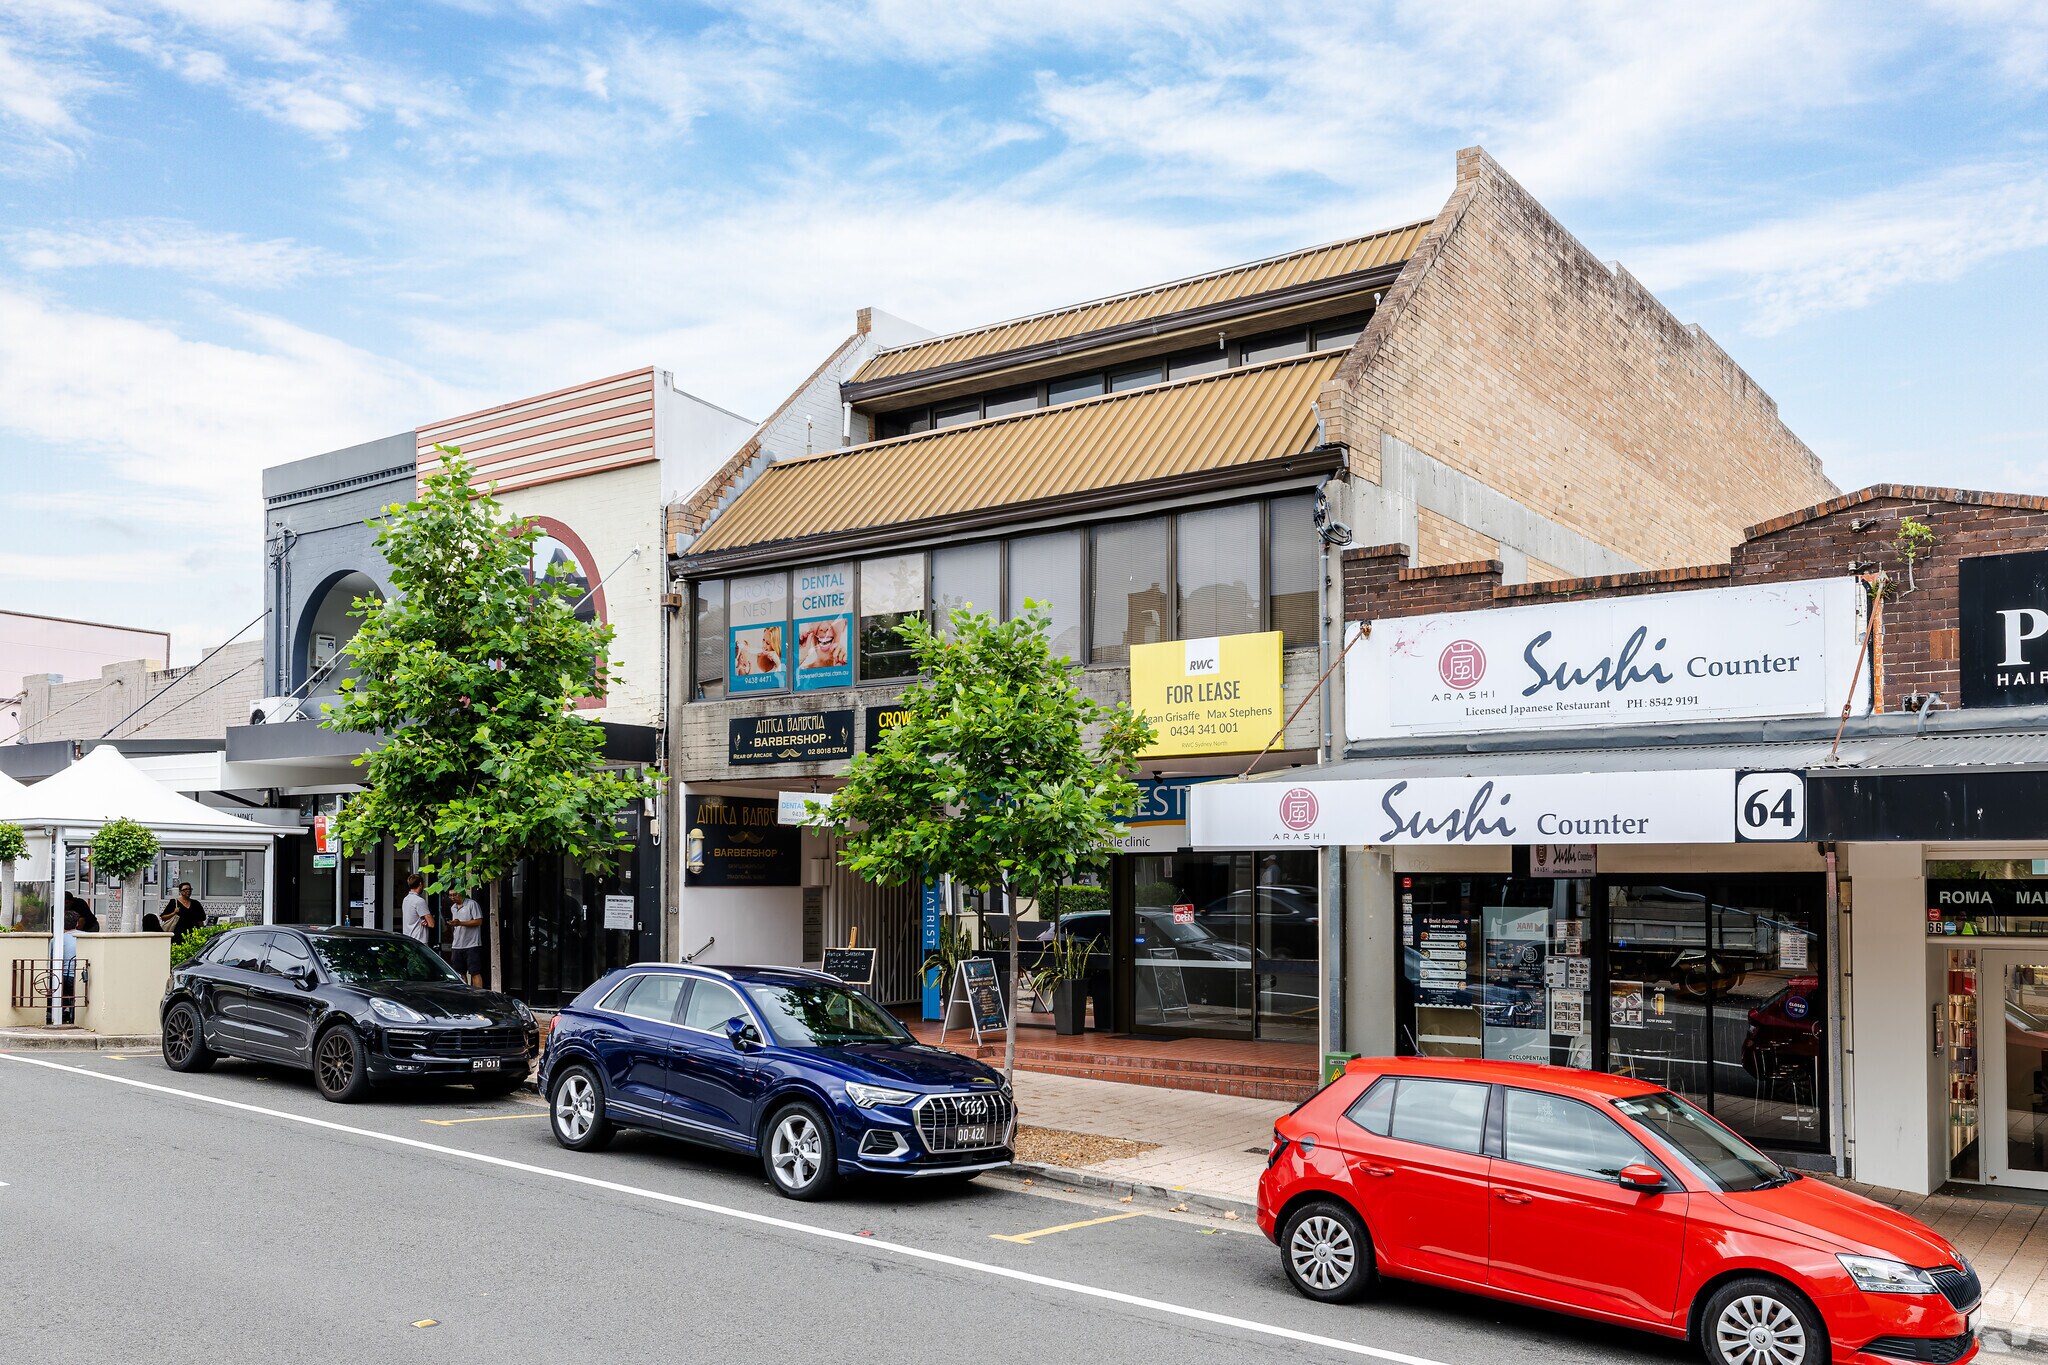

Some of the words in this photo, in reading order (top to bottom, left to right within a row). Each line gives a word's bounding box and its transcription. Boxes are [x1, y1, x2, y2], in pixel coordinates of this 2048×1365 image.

[802, 573, 845, 591] DENTAL
[802, 592, 845, 610] CENTRE
[742, 601, 774, 617] NEST
[1189, 658, 1214, 671] RWC
[1521, 625, 1673, 697] Sushi
[1686, 653, 1800, 679] Counter
[744, 676, 758, 685] 9438
[758, 675, 772, 683] 4471
[1166, 684, 1194, 704] FOR
[1198, 680, 1241, 702] LEASE
[1431, 690, 1495, 701] ARASHI
[1465, 705, 1507, 716] Licensed
[1509, 703, 1553, 715] Japanese
[1556, 699, 1611, 711] Restaurant
[1649, 697, 1673, 707] 8542
[1675, 695, 1699, 706] 9191
[1165, 711, 1200, 722] Grisaffe
[1207, 709, 1227, 719] Max
[1229, 706, 1273, 719] Stephens
[755, 718, 784, 734] ANTICA
[787, 714, 825, 732] BARBERIA
[1170, 725, 1195, 737] 0434
[1197, 724, 1217, 735] 341
[1219, 722, 1238, 734] 001
[754, 733, 827, 748] BARBERSHOP
[1194, 741, 1212, 749] Sydney
[832, 746, 848, 754] 5744
[781, 801, 805, 809] DENTAL
[1379, 780, 1517, 842] Sushi
[1537, 812, 1650, 835] Counter
[1743, 788, 1796, 828] 64
[696, 804, 737, 825] ANTICA
[742, 806, 790, 828] BARBE
[1125, 836, 1151, 847] clinic
[1272, 832, 1326, 840] ARASHI
[713, 848, 778, 857] BARBERSHOP
[1939, 891, 1993, 904] ROMA
[668, 906, 678, 914] 60
[1174, 913, 1193, 922] OPEN
[926, 891, 936, 948] IATRIST
[1928, 922, 1942, 933] 66
